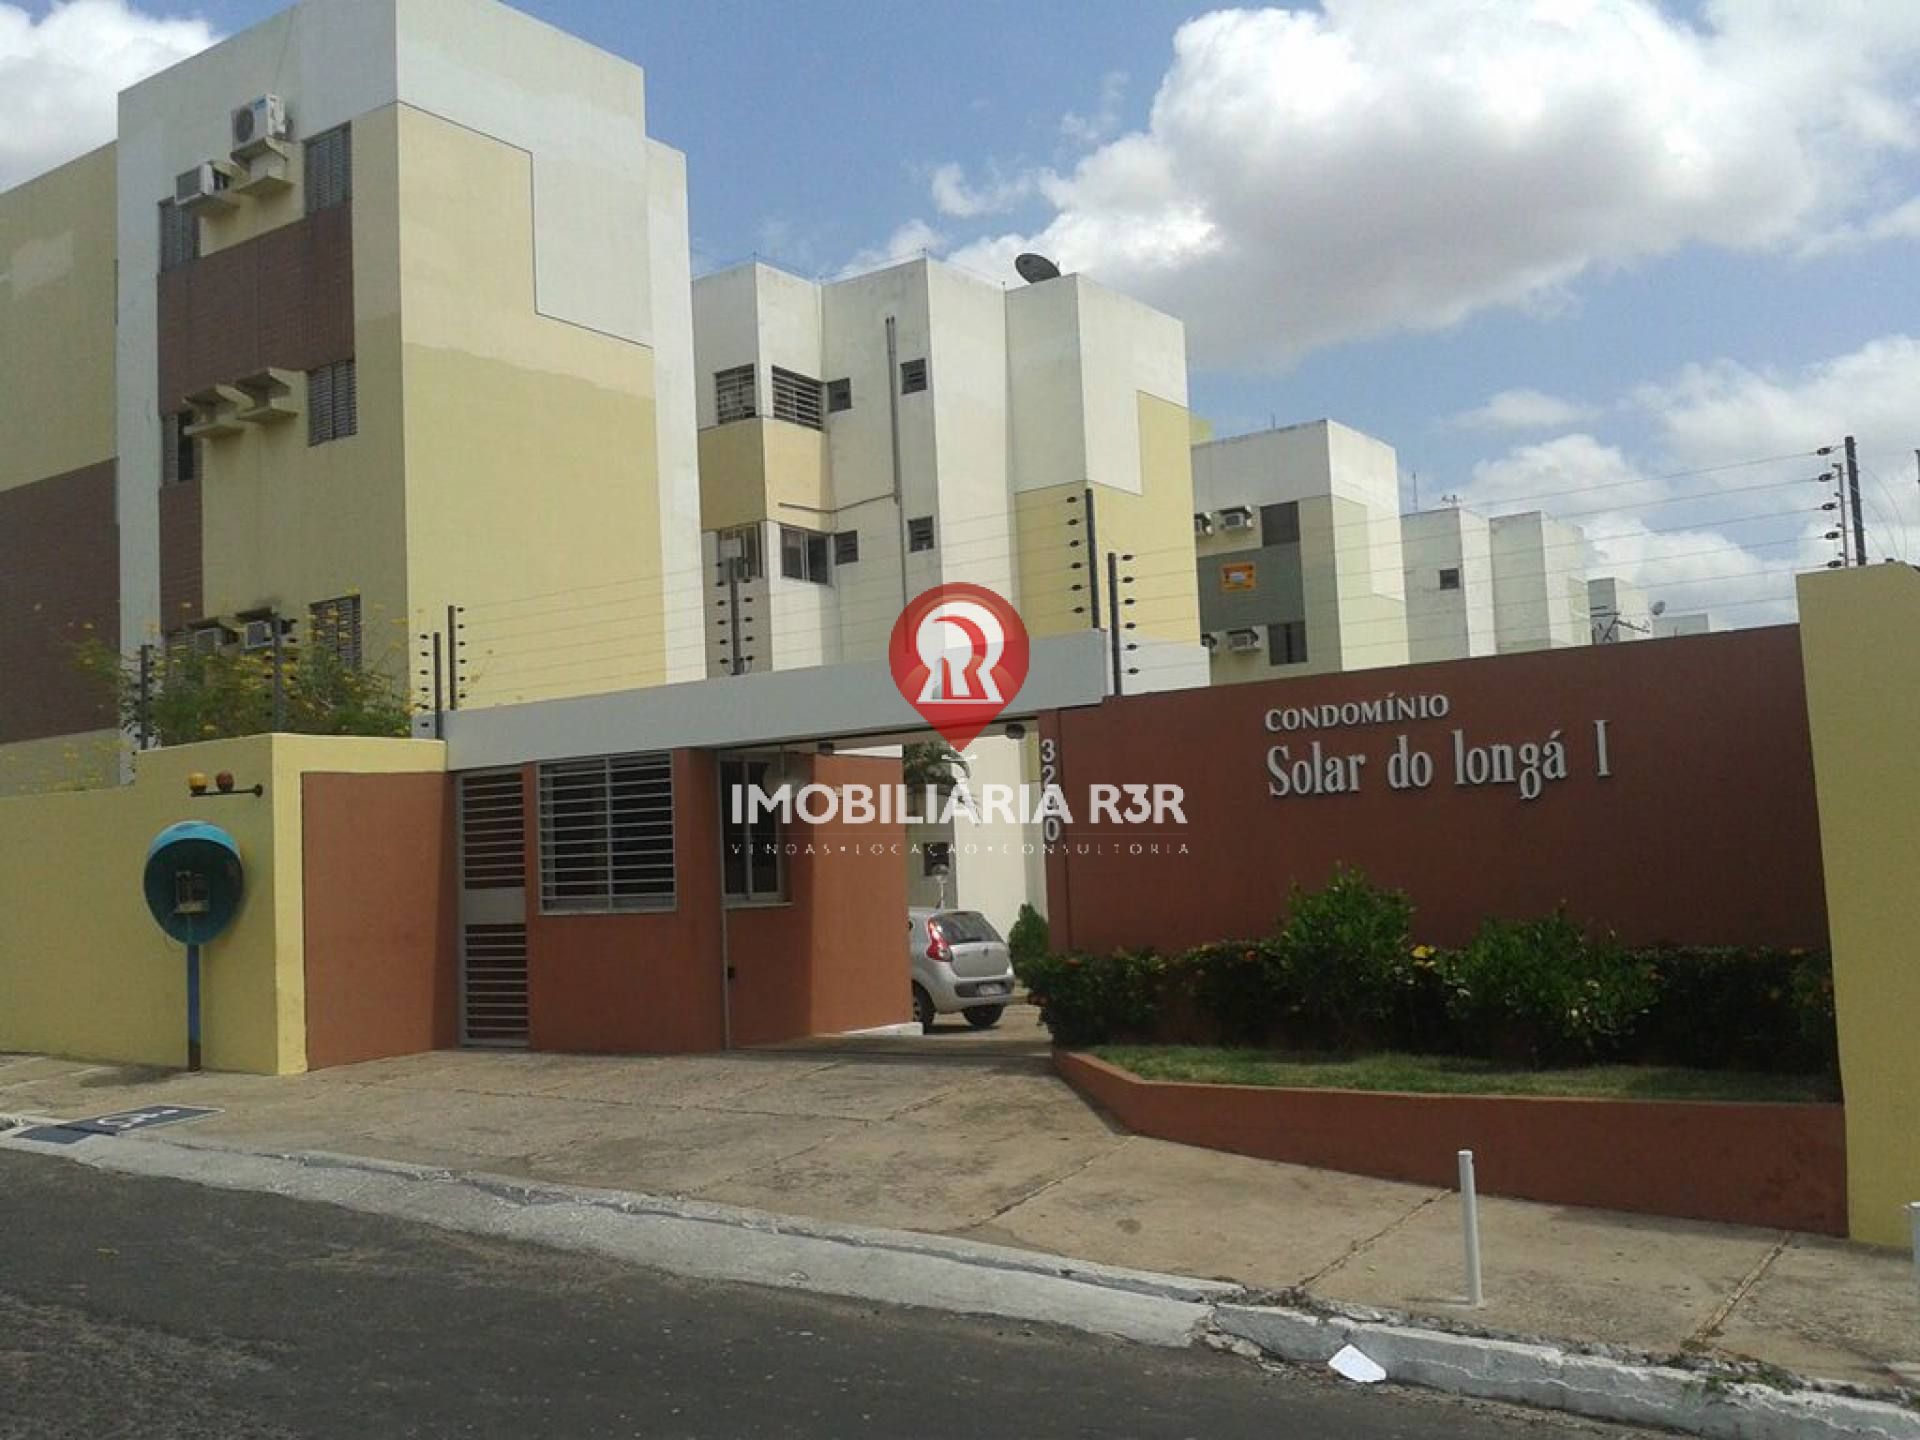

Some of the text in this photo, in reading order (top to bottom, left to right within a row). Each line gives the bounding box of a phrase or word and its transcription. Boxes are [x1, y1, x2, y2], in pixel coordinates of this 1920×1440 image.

[1264, 692, 1449, 732] CONDOMÍNIO
[1266, 740, 1366, 797] Solar
[1387, 734, 1433, 790] do
